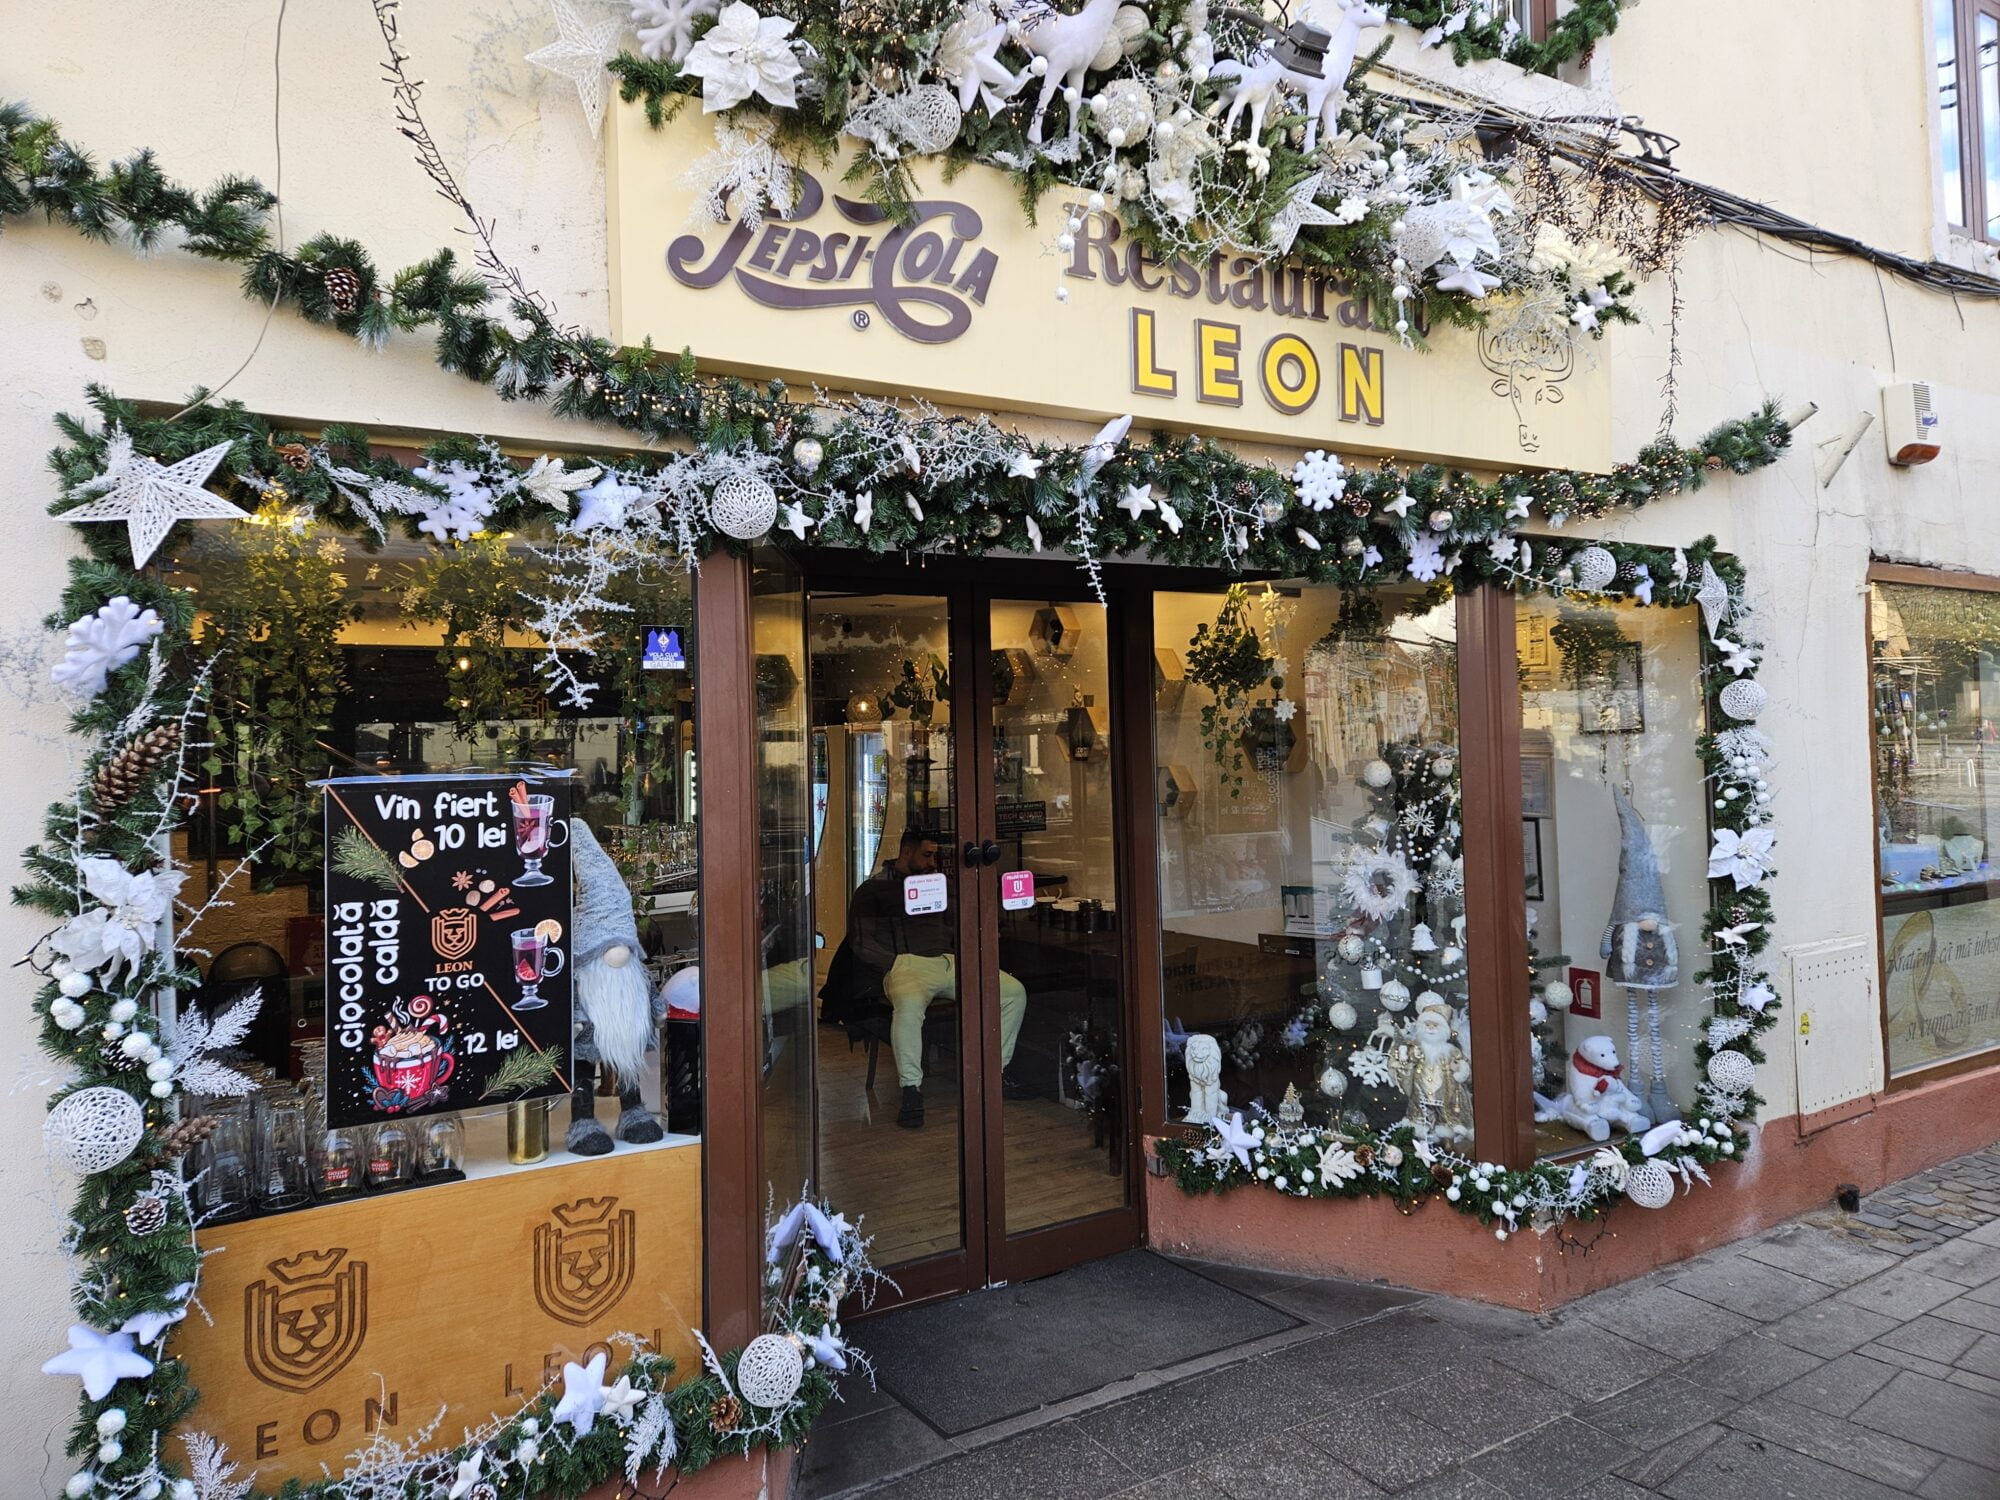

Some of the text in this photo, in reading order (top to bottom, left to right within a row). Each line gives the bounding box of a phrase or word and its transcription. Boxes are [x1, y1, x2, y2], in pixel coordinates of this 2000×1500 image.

[1063, 202, 1430, 338] Restaurat
[1129, 306, 1385, 426] LEON
[374, 791, 499, 820] Vin fiert
[434, 822, 507, 850] 10 lei
[368, 899, 400, 984] caldă
[331, 902, 365, 1048] ciocolată
[435, 960, 474, 974] LEON
[424, 973, 485, 992] TO GO
[463, 1030, 519, 1055] 12 lei
